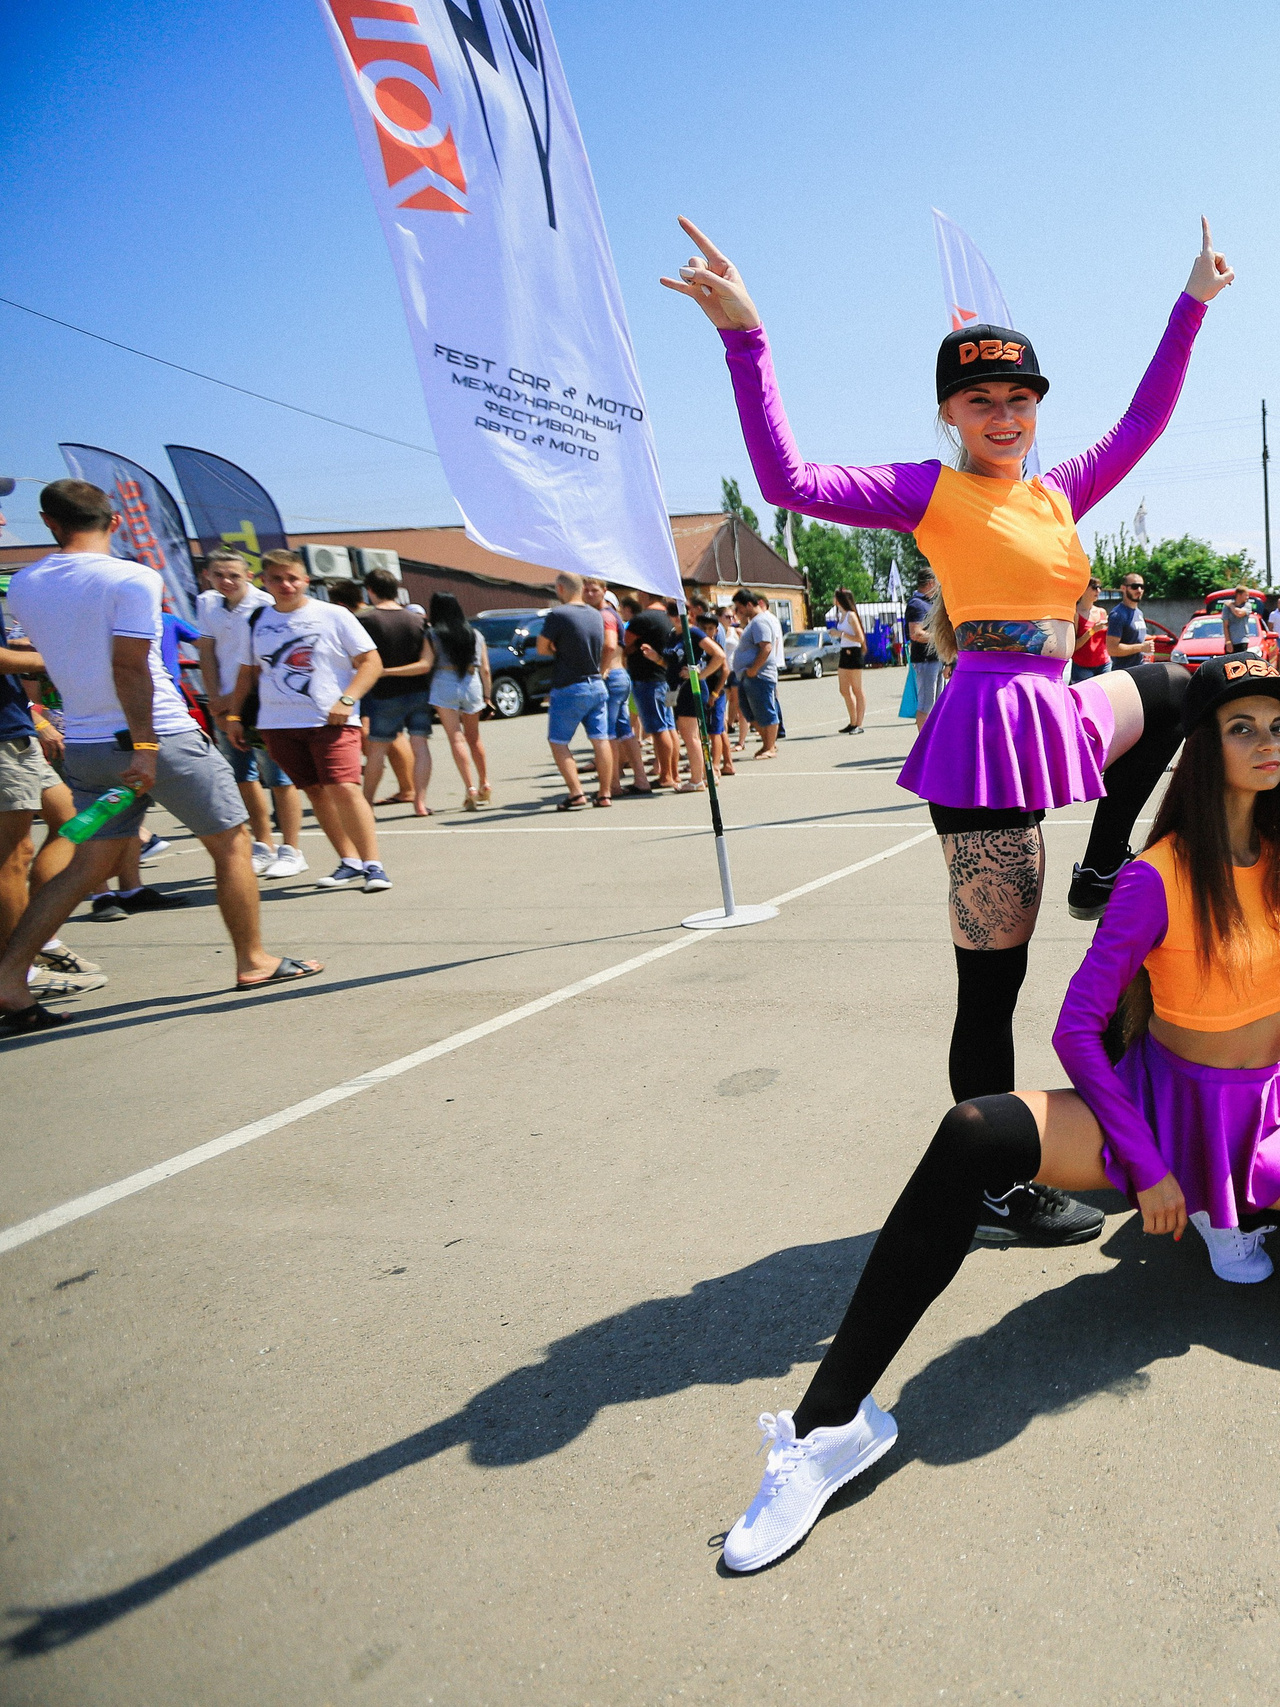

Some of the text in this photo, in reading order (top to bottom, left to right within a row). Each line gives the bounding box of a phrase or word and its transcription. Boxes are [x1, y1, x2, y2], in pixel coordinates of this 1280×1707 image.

[434, 342, 497, 373] FEST
[508, 367, 551, 393] CAR
[586, 392, 644, 422] MOTO
[452, 372, 622, 434] МЕЖДУНАРОДНЫЙ
[474, 415, 527, 442] АВТО
[549, 437, 599, 462] МОТО
[484, 400, 597, 443] ФЕСТИВАЛЬ
